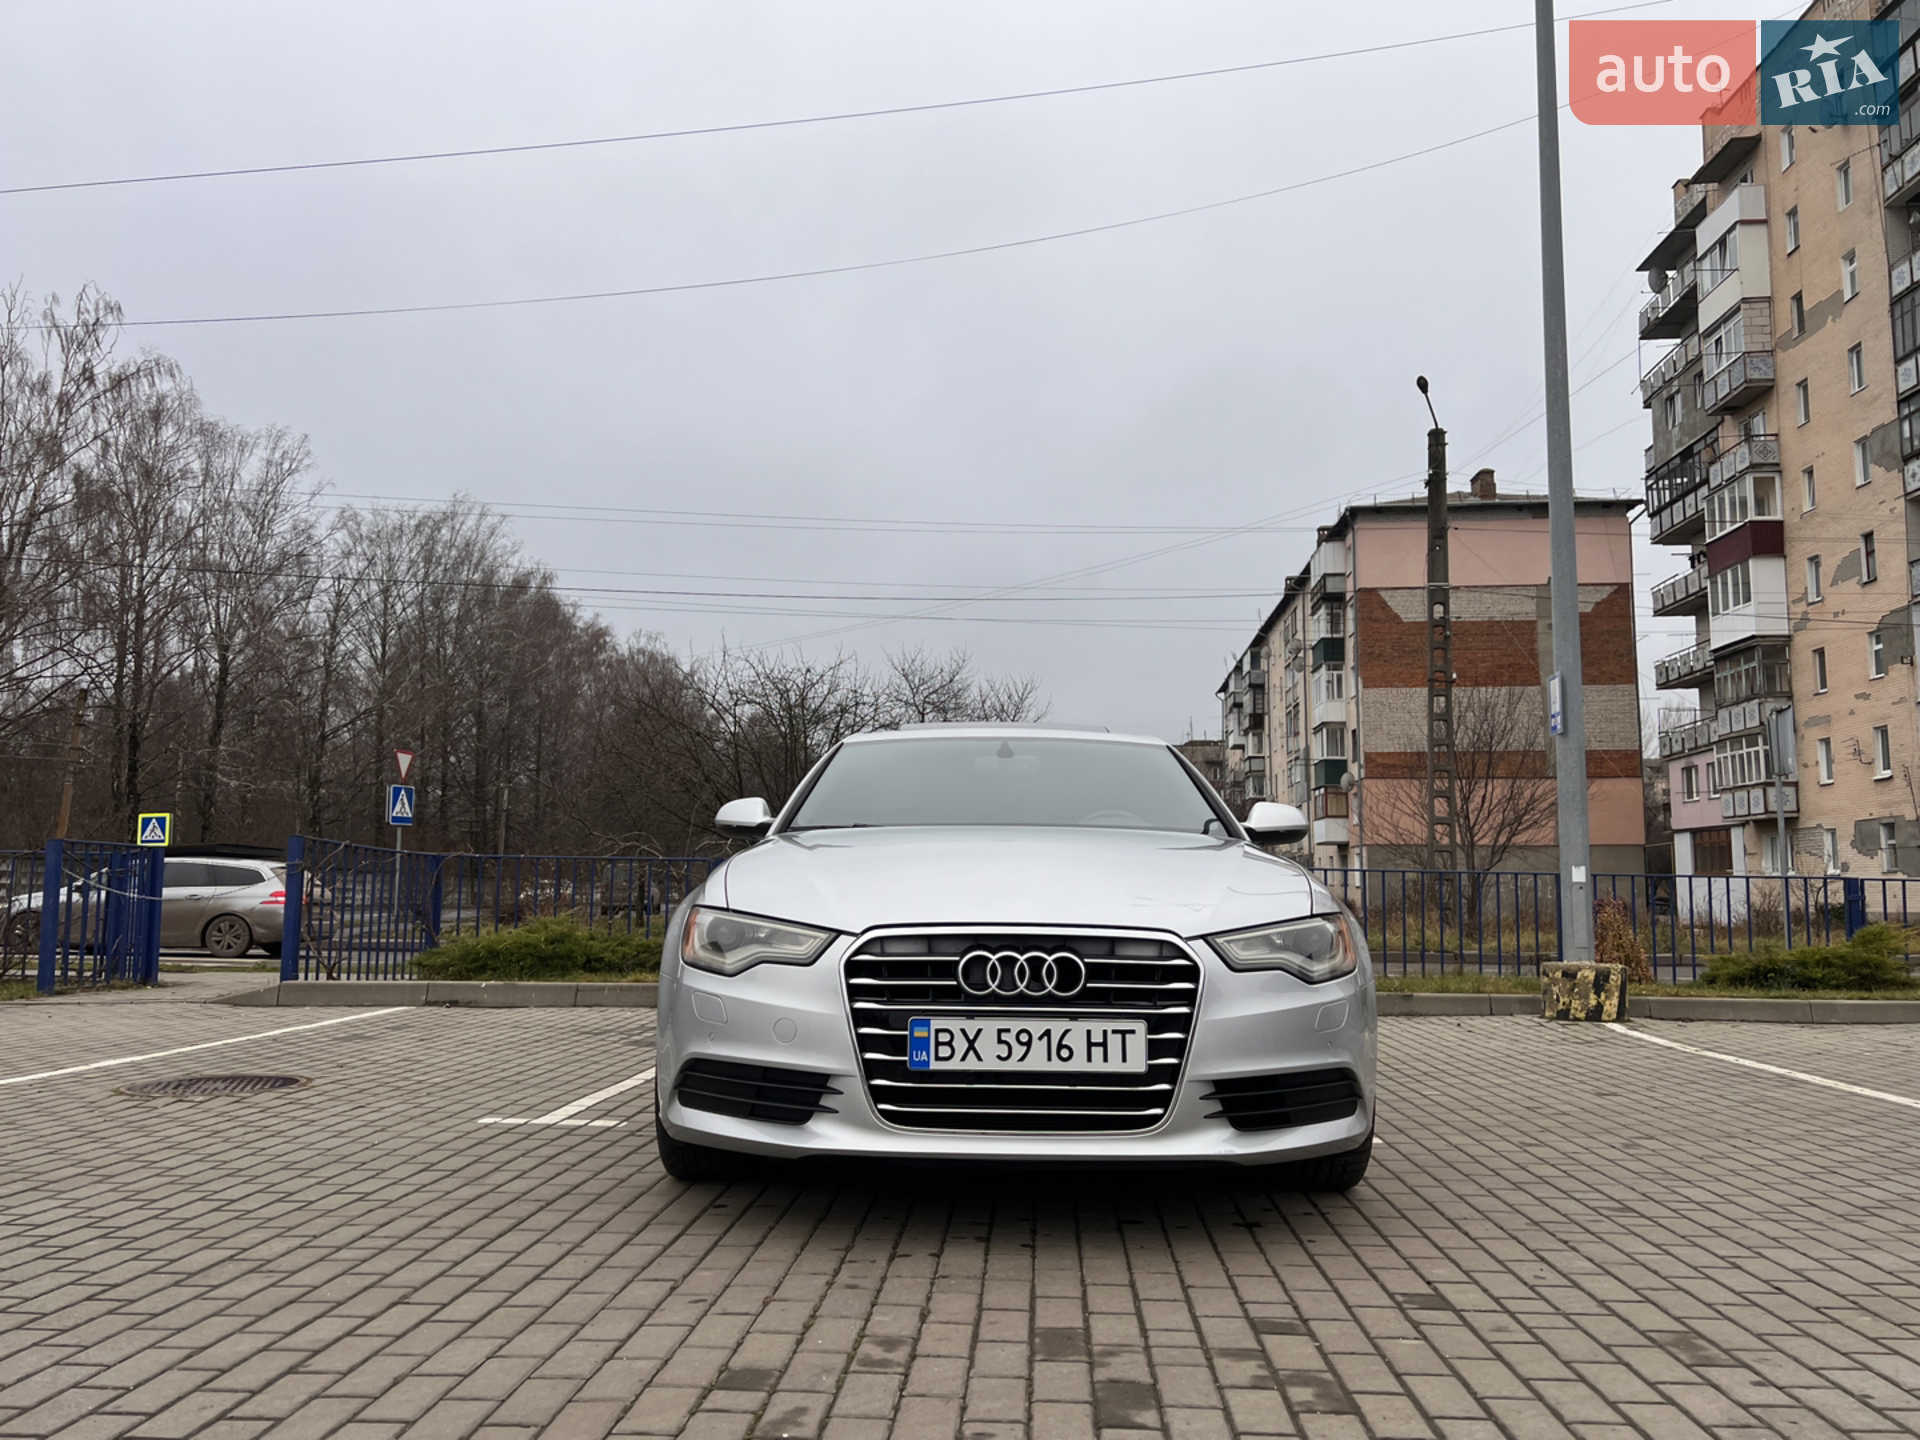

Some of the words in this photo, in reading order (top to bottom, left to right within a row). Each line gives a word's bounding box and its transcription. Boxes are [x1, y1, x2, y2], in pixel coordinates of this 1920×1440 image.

[912, 1050, 929, 1062] UA
[934, 1027, 984, 1063] BX
[995, 1027, 1075, 1063] 5916
[1085, 1028, 1137, 1064] HT
